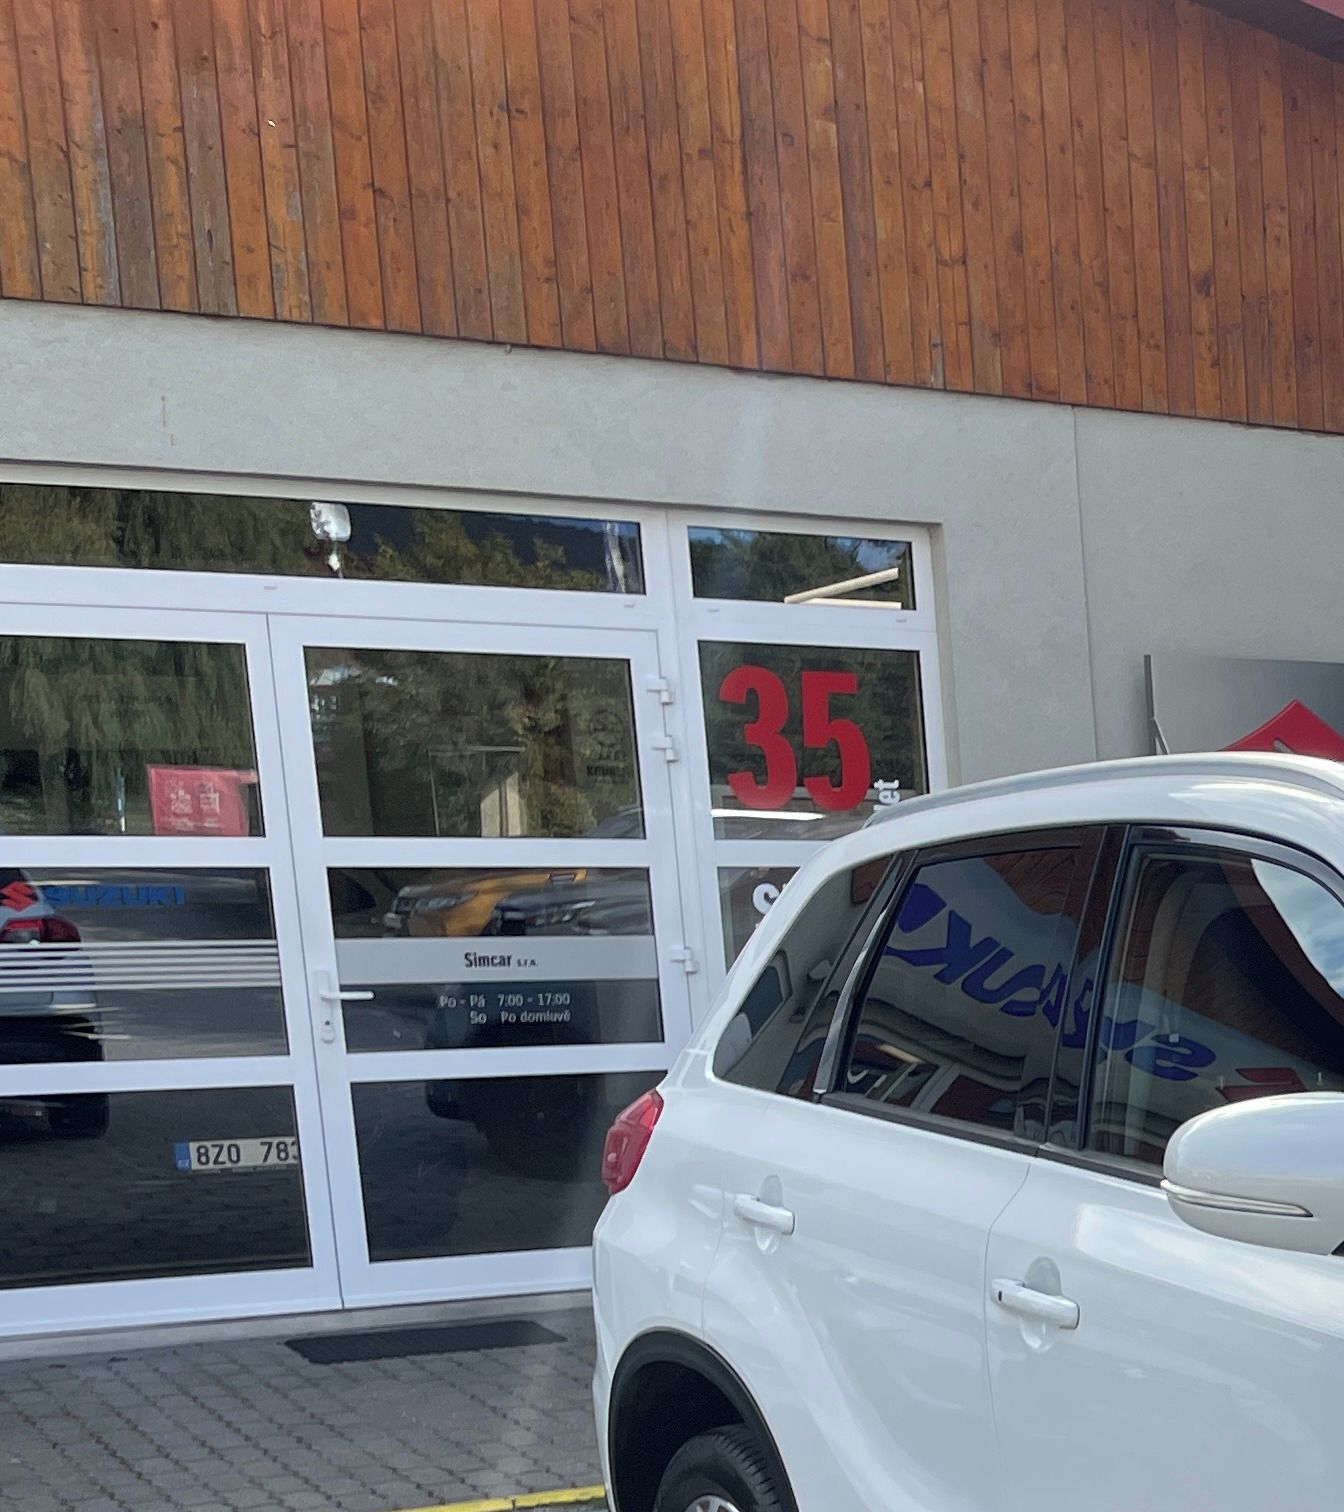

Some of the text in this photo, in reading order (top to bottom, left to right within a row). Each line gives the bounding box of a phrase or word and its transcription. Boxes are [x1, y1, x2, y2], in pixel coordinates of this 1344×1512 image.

[719, 665, 871, 812] 35
[464, 952, 512, 968] Simcar
[440, 995, 457, 1008] Po
[497, 993, 524, 1007] 7:00
[537, 992, 571, 1006] 17:00
[470, 1010, 487, 1024] So
[501, 1010, 517, 1024] Po
[196, 1143, 241, 1166] 8Z0
